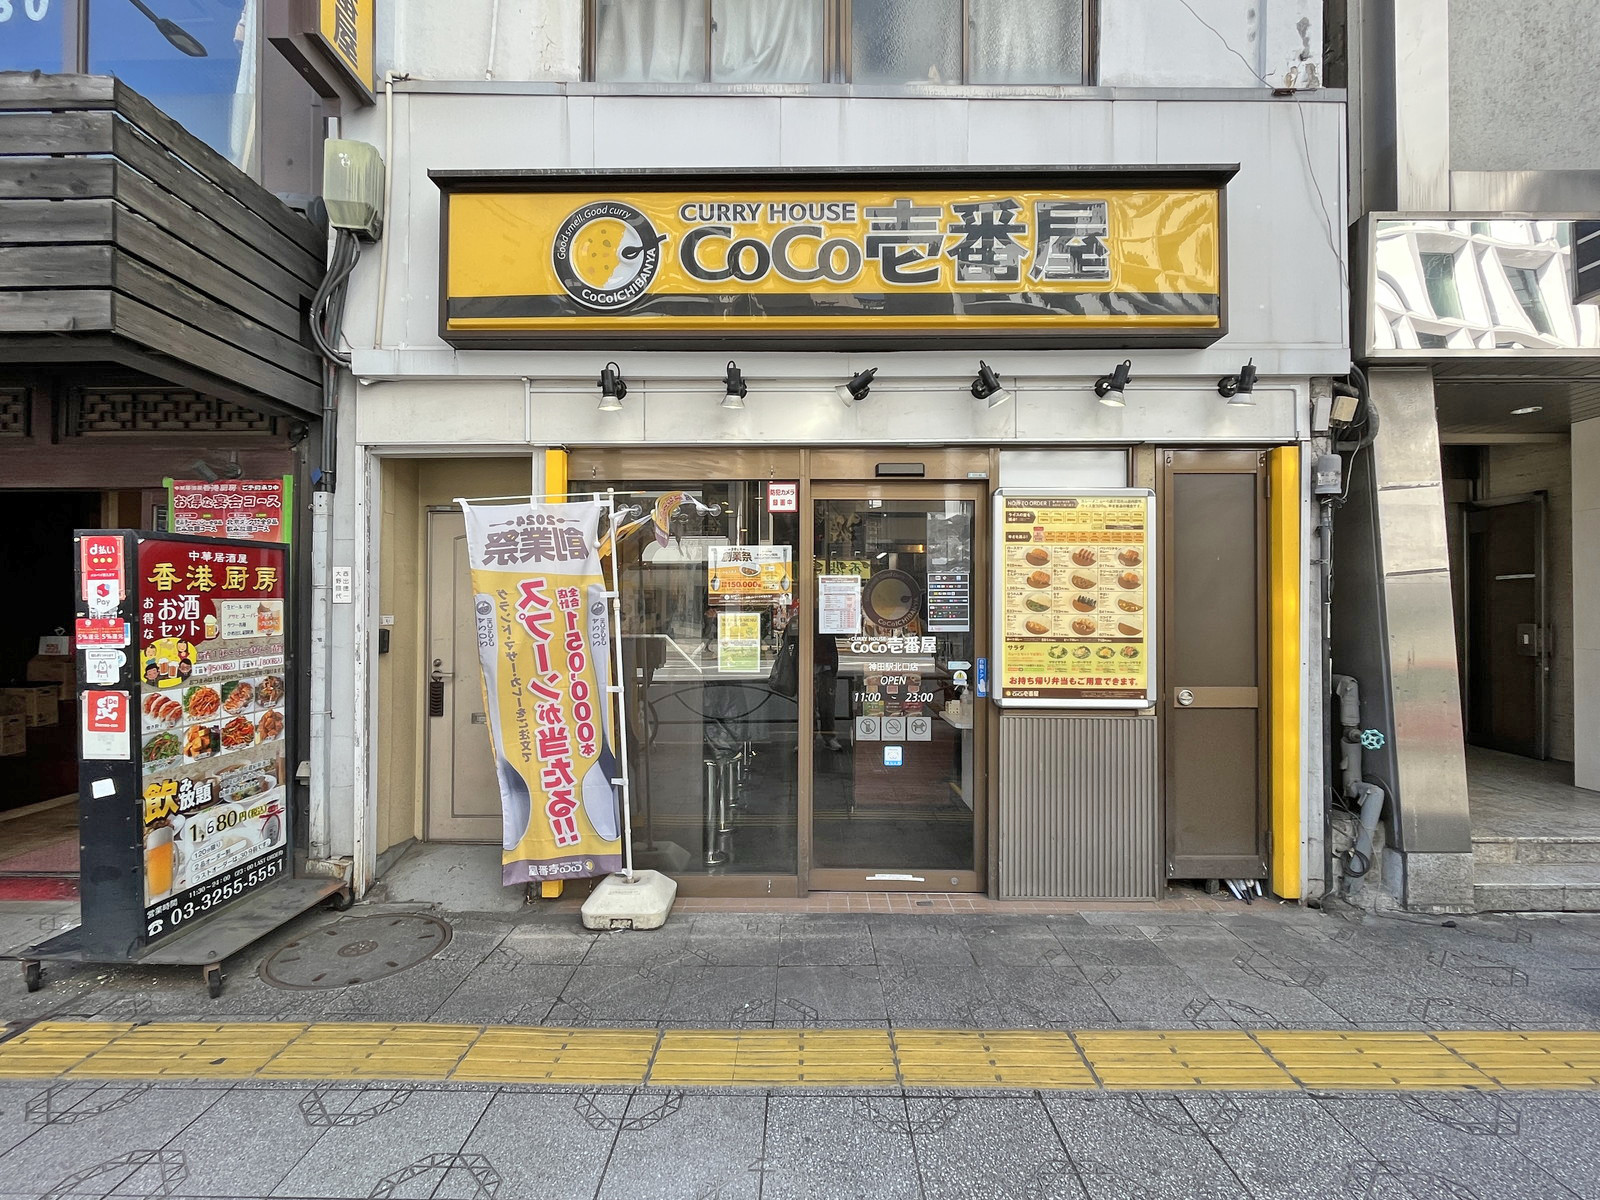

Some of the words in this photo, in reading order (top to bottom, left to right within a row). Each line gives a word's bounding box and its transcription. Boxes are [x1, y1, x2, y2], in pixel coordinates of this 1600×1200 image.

[679, 202, 761, 222] CURRY
[768, 202, 857, 222] HOUSE
[557, 234, 568, 260] Good
[584, 205, 608, 219] Good
[609, 206, 632, 219] curry
[581, 247, 656, 303] CoCoICHIBANYA
[770, 488, 795, 496] 防犯カメラ
[174, 494, 281, 509] お得な宴会コース
[89, 544, 115, 555] d払い
[188, 551, 249, 564] 中華居酒屋
[148, 562, 278, 592] 香港厨房
[96, 598, 111, 606] Pay
[158, 594, 201, 620] お酒
[158, 621, 201, 638] セット
[868, 662, 919, 672] 神田駅北口店
[880, 676, 907, 685] OPEN
[1009, 676, 1139, 686] お持ち帰り弁当もご用意できます。
[854, 692, 881, 702] 11:00
[905, 692, 934, 702] 23:00
[143, 778, 212, 824] 飲み放題
[171, 858, 283, 925] 03-3255-5551
